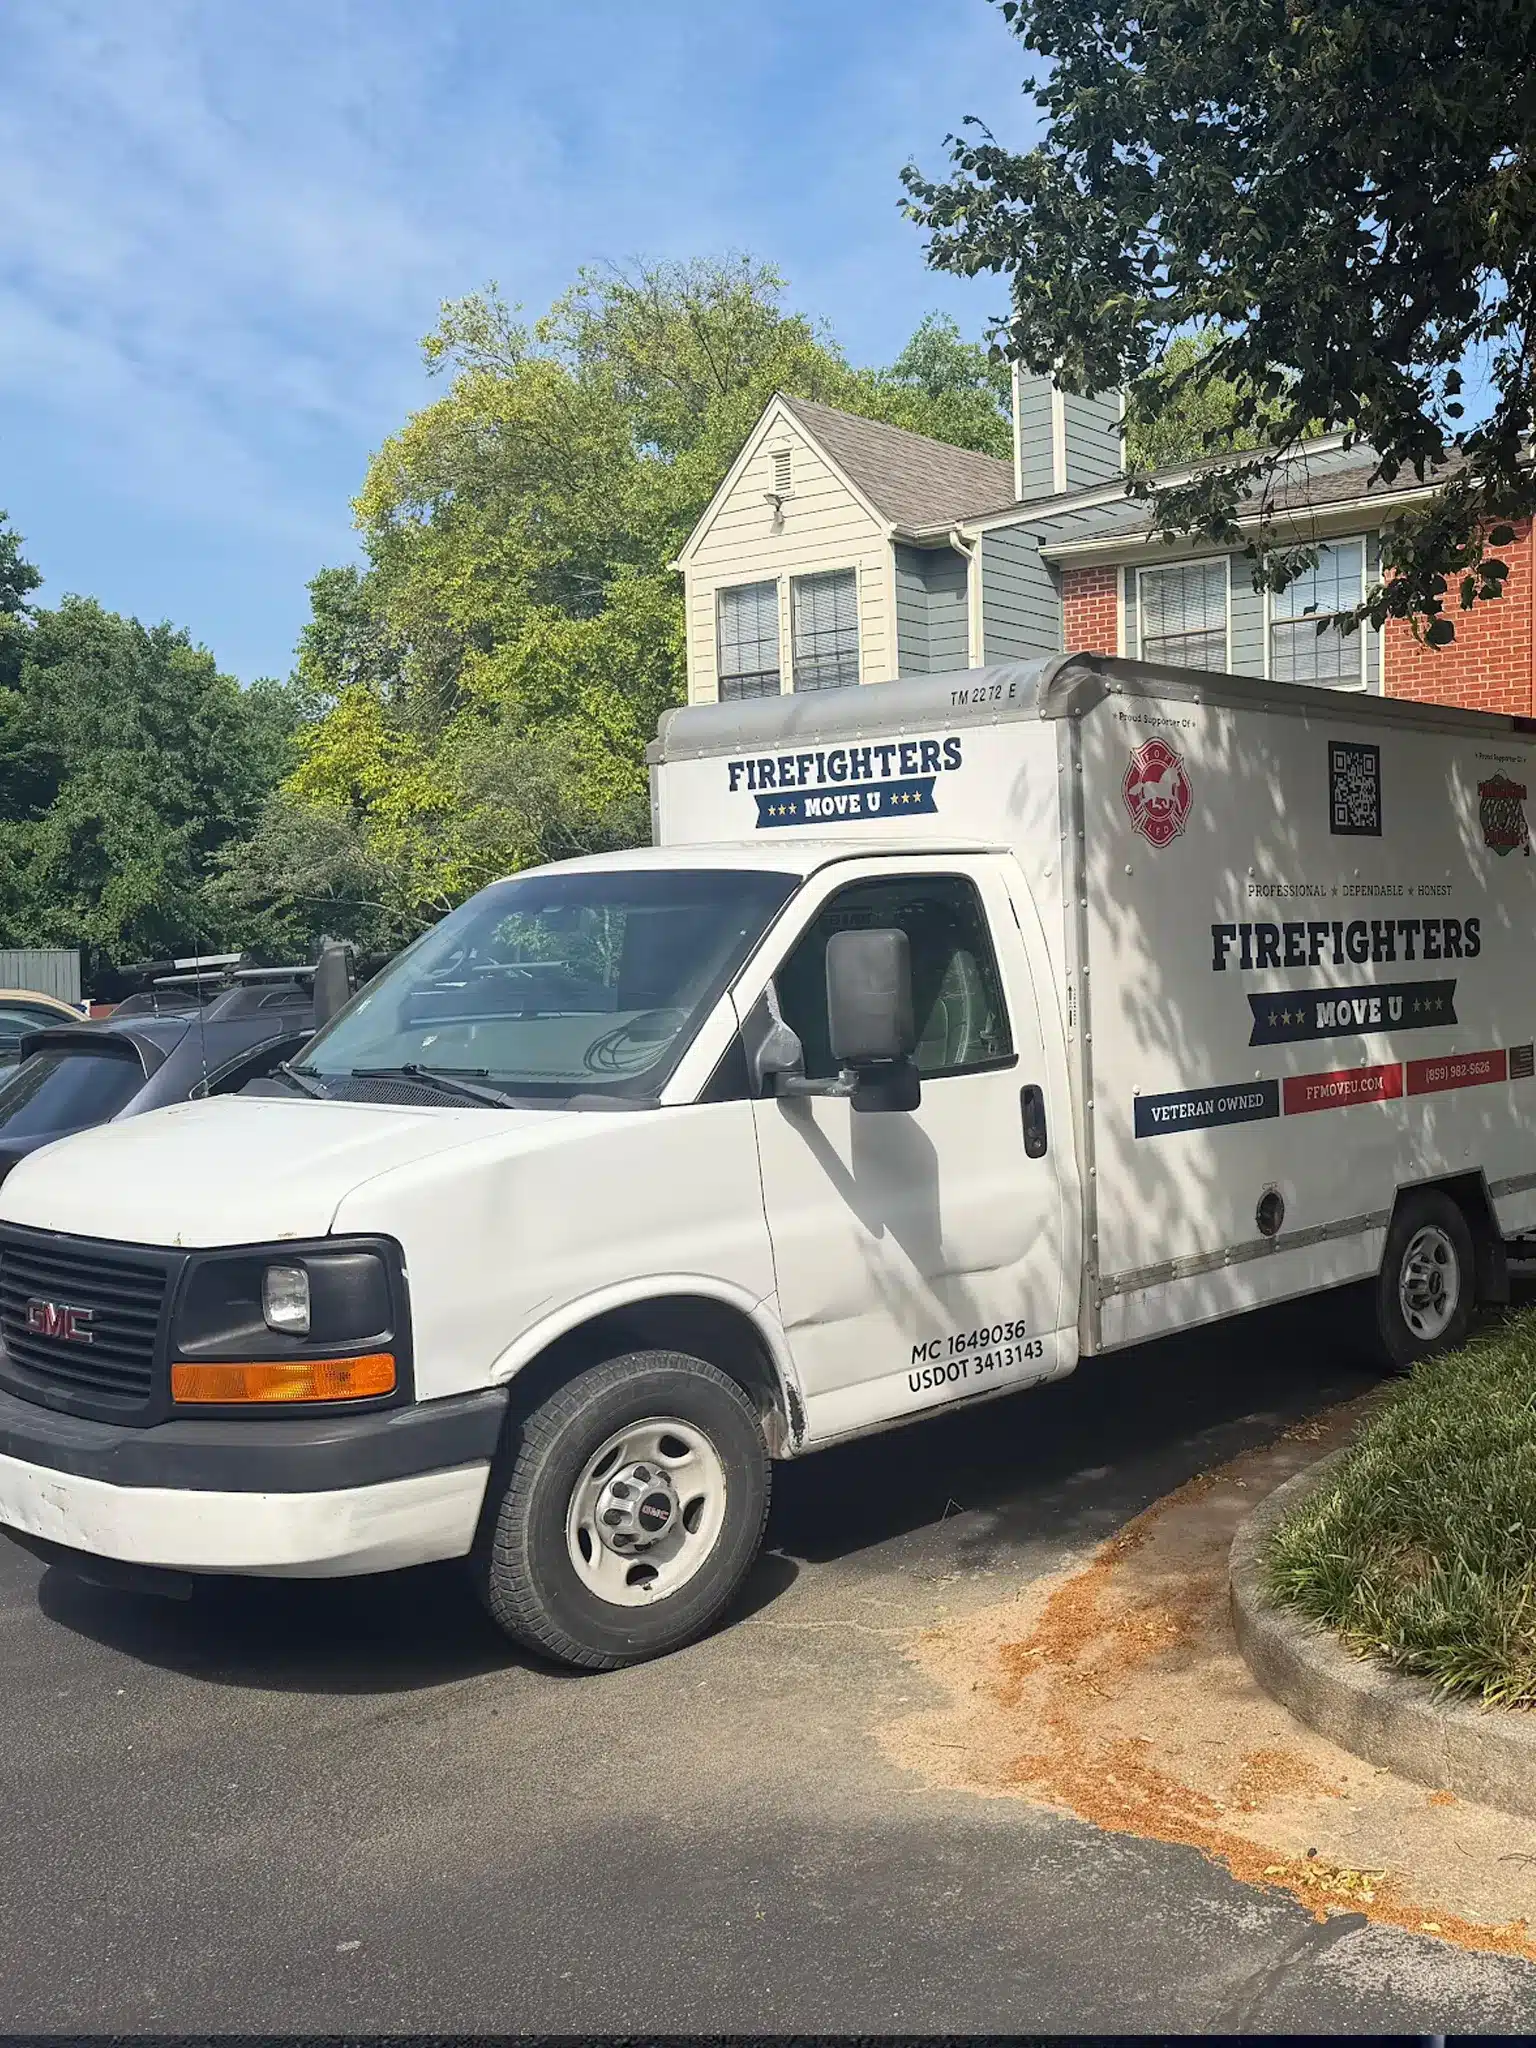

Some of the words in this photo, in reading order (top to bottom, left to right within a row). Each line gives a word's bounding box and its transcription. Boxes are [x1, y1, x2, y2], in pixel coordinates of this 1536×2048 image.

[951, 690, 969, 706] TM
[972, 684, 1002, 703] 2272
[1009, 683, 1016, 698] E
[1119, 711, 1141, 722] Proud
[728, 737, 963, 791] FIREFIGHTERS
[804, 793, 860, 818] MOVE
[867, 791, 880, 811] U
[1248, 884, 1327, 897] PROFESSIONAL
[1342, 885, 1404, 897] DEPENDABLE
[1417, 885, 1453, 896] HONEST
[1211, 917, 1481, 971] FIREFIGHTERS
[1316, 998, 1382, 1028] MOVE
[1389, 996, 1403, 1021] U
[1425, 1065, 1448, 1083] (859)
[1306, 1077, 1384, 1101] FFMOVEU.COM
[1151, 1101, 1214, 1122] VETERAN
[1217, 1094, 1264, 1113] OWNED
[27, 1298, 93, 1342] GMC
[911, 1340, 942, 1364] MC
[948, 1319, 1026, 1355] 1649036
[908, 1359, 970, 1393] USDOT
[974, 1340, 1044, 1375] 3413143
[641, 1504, 670, 1521] GMC
